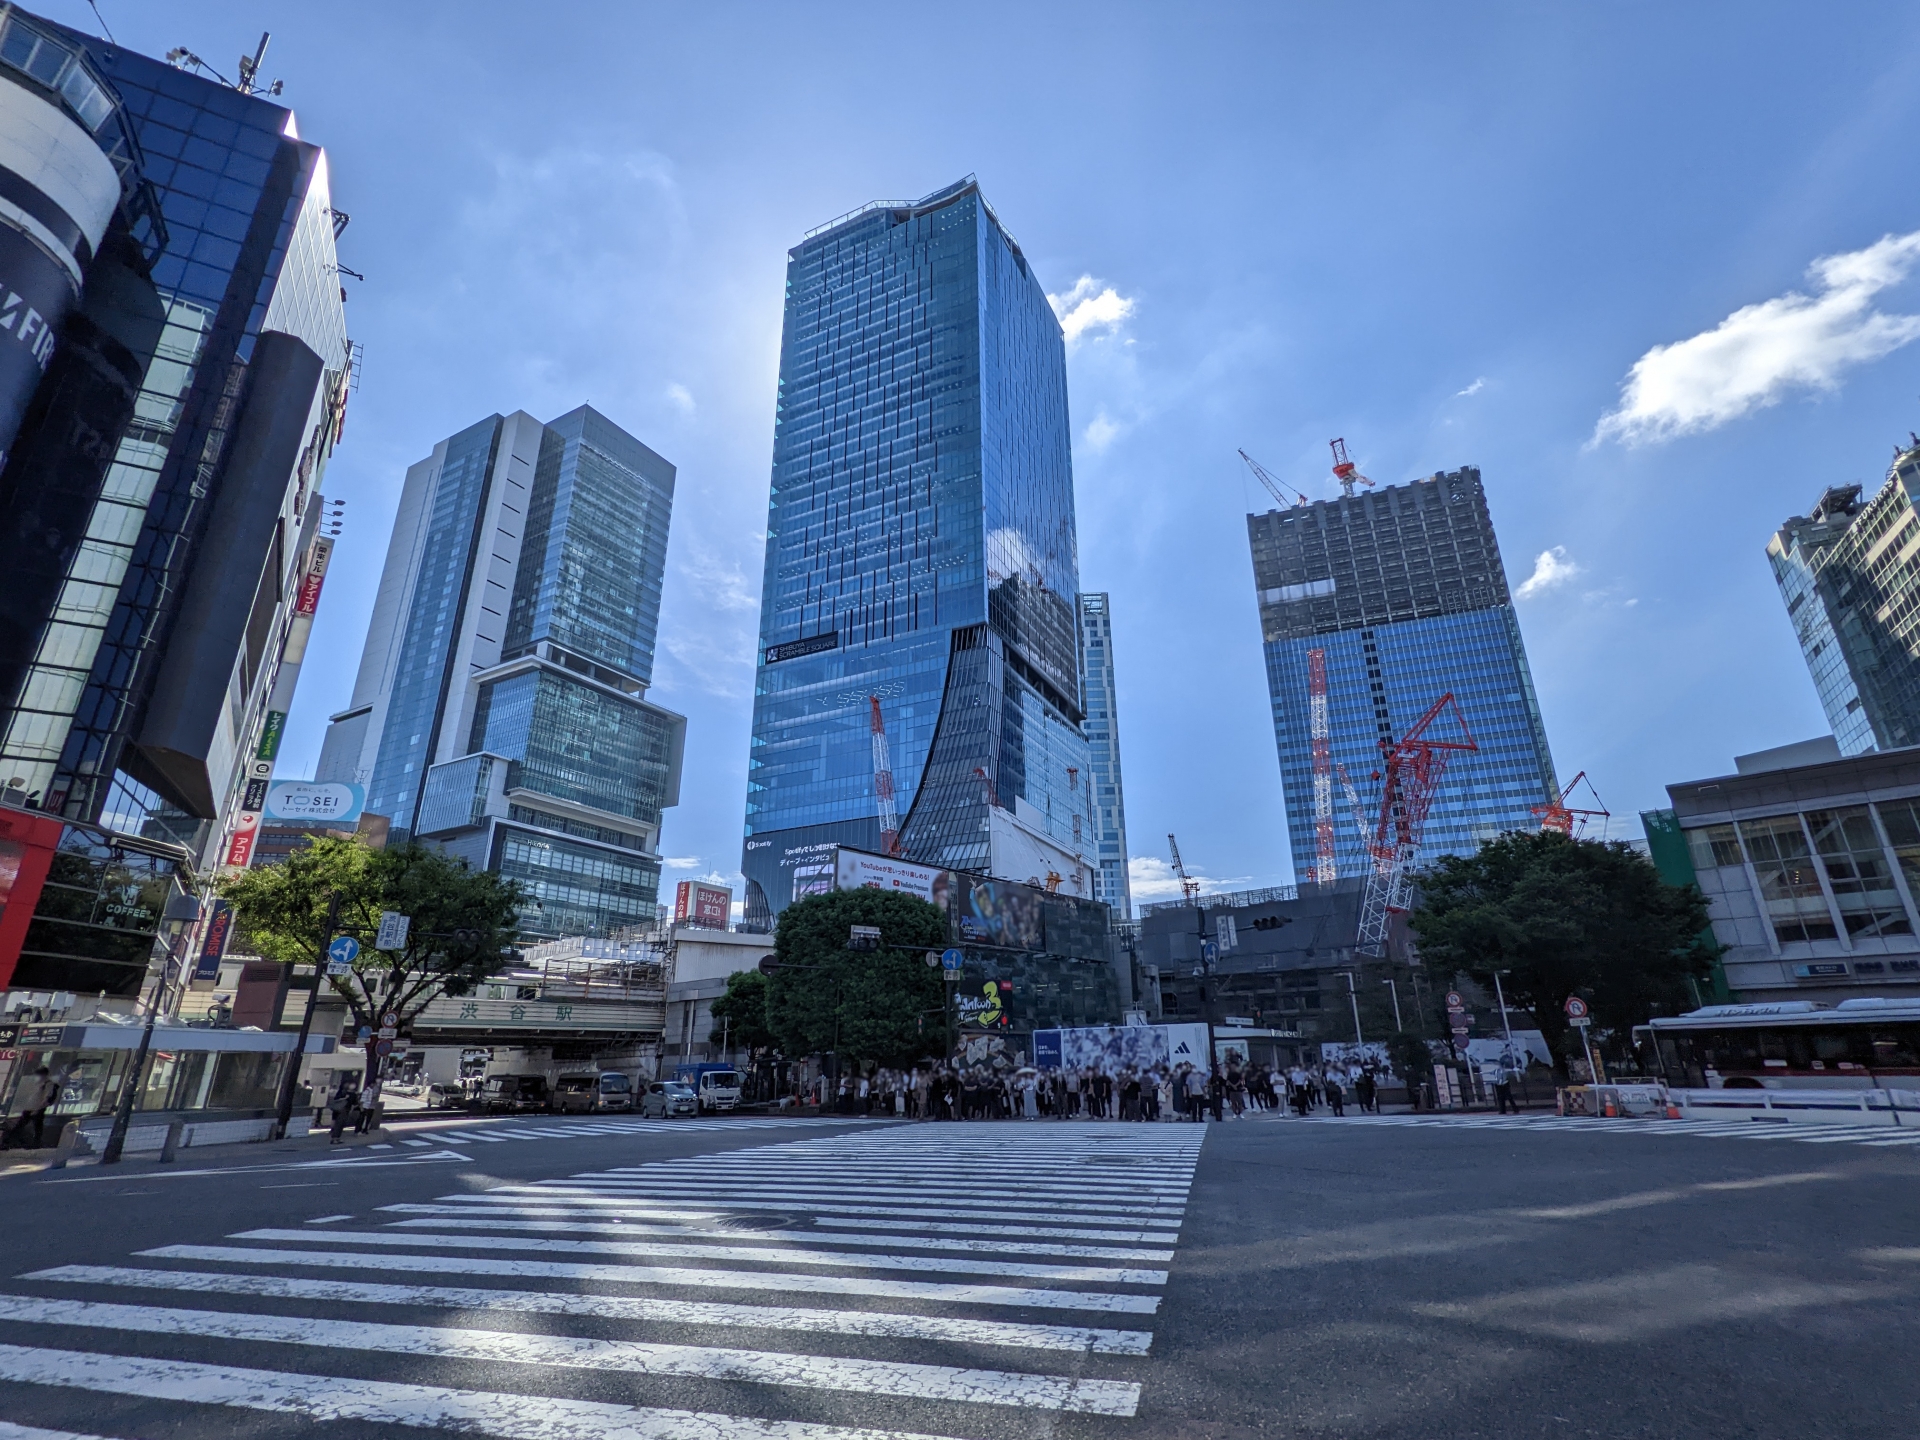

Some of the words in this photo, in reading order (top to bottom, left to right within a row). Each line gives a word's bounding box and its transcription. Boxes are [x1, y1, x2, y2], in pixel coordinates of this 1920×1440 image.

[302, 583, 319, 612] アイフル
[779, 642, 805, 652] SHIBUYA
[779, 646, 810, 658] SCRAMBLE
[811, 640, 837, 652] SQUARE
[282, 806, 336, 814] トーセイ株式会社
[231, 837, 249, 862] アコム
[697, 891, 727, 905] ほけんの
[106, 903, 147, 918] COFFEE
[383, 914, 397, 947] 渋谷駅前
[459, 1001, 573, 1021] 渋谷駅
